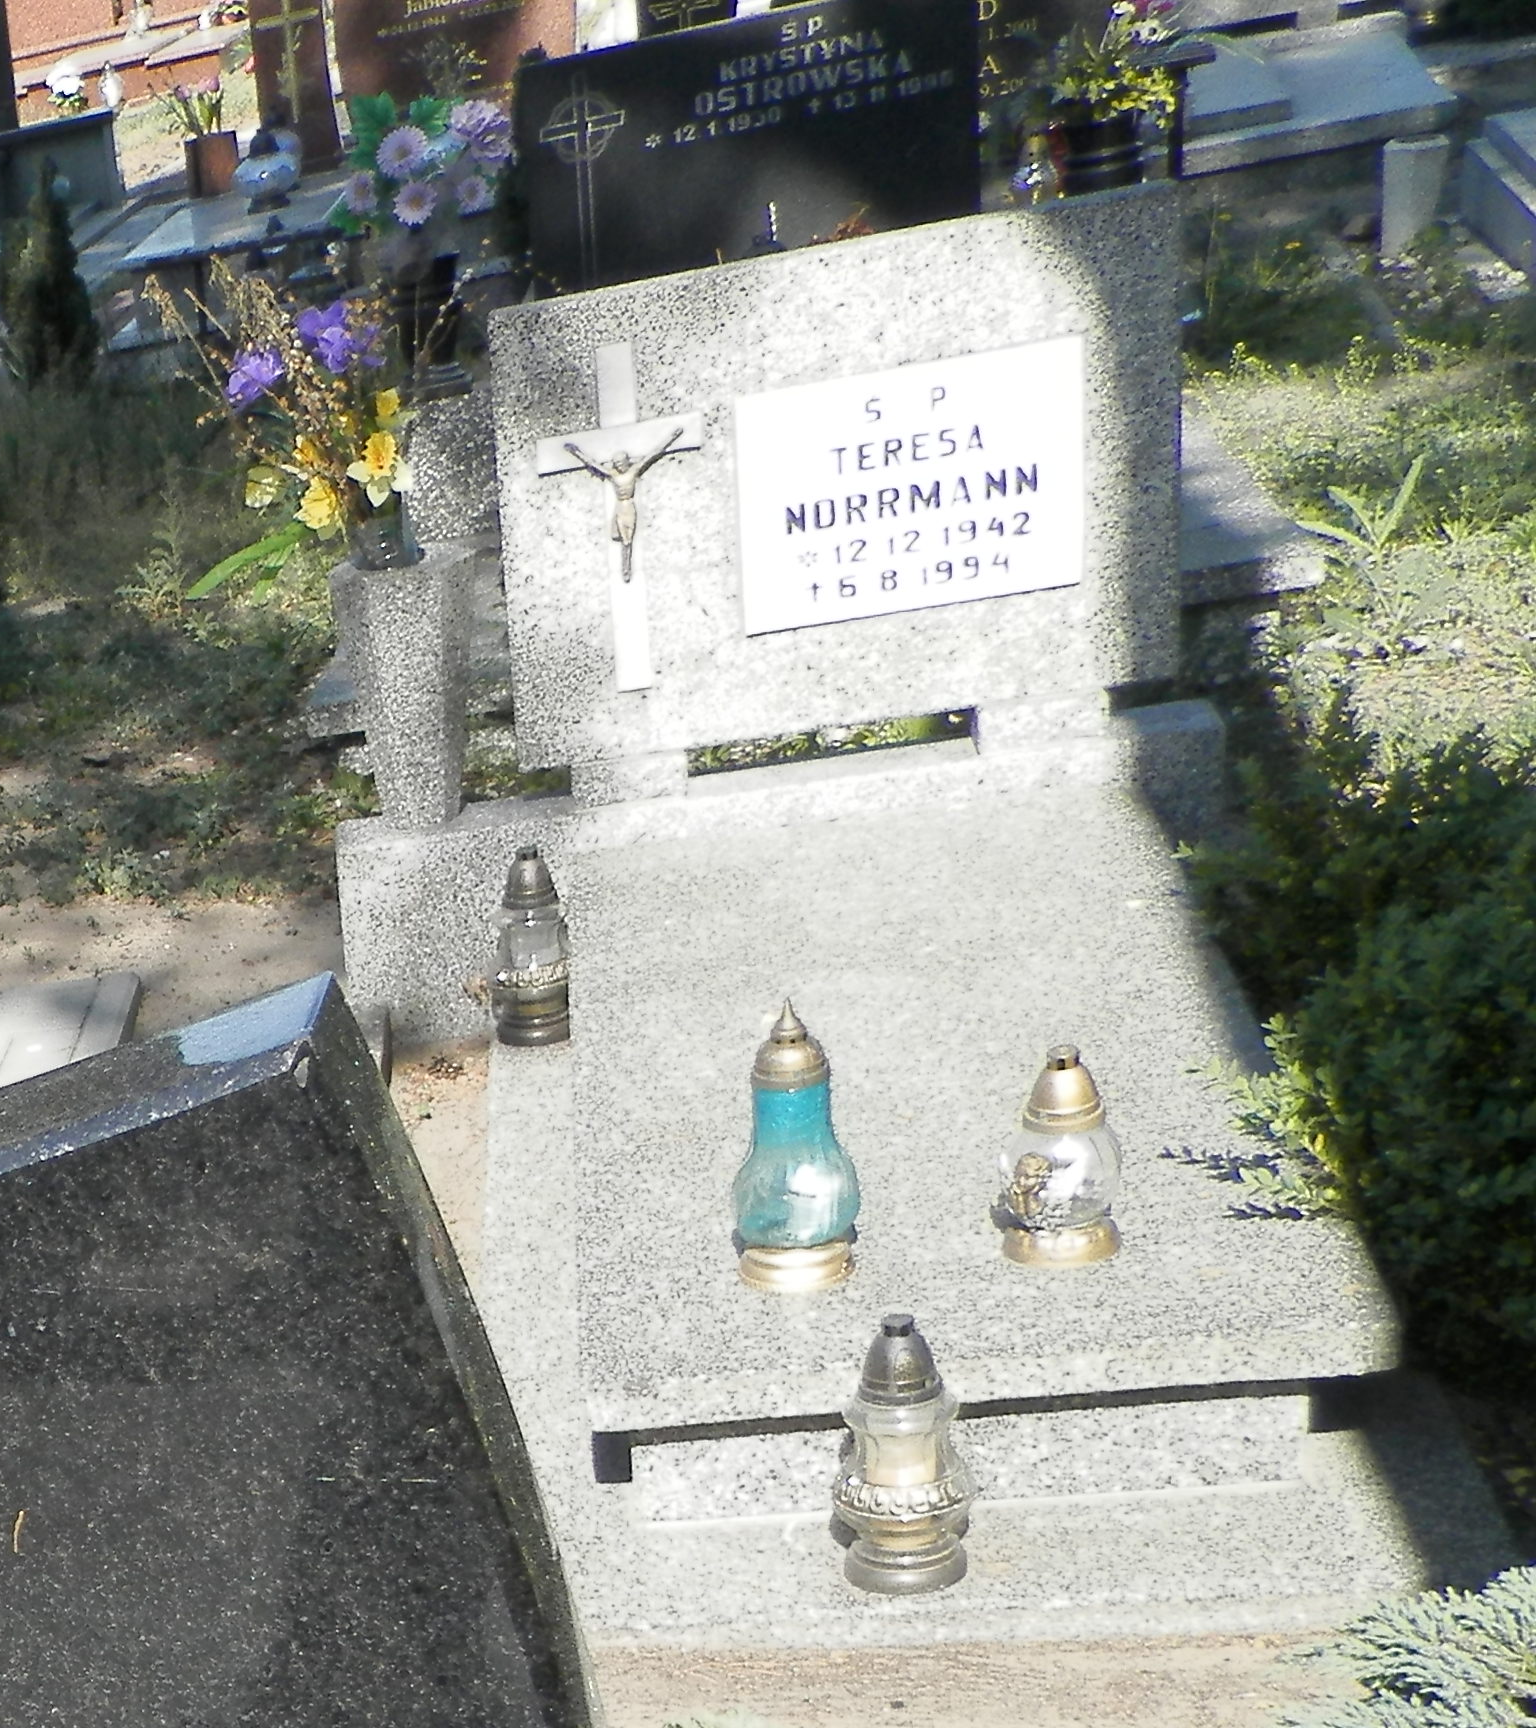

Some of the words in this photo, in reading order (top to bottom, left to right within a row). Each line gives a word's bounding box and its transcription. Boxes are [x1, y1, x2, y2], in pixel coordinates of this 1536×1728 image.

[718, 29, 883, 83] KRYSTYNA
[694, 50, 912, 116] OSTROWSKA
[830, 424, 984, 475] TERESA
[785, 463, 1038, 535] NORRMANN
[943, 511, 1032, 546] 1942
[923, 552, 1010, 585] 1994
